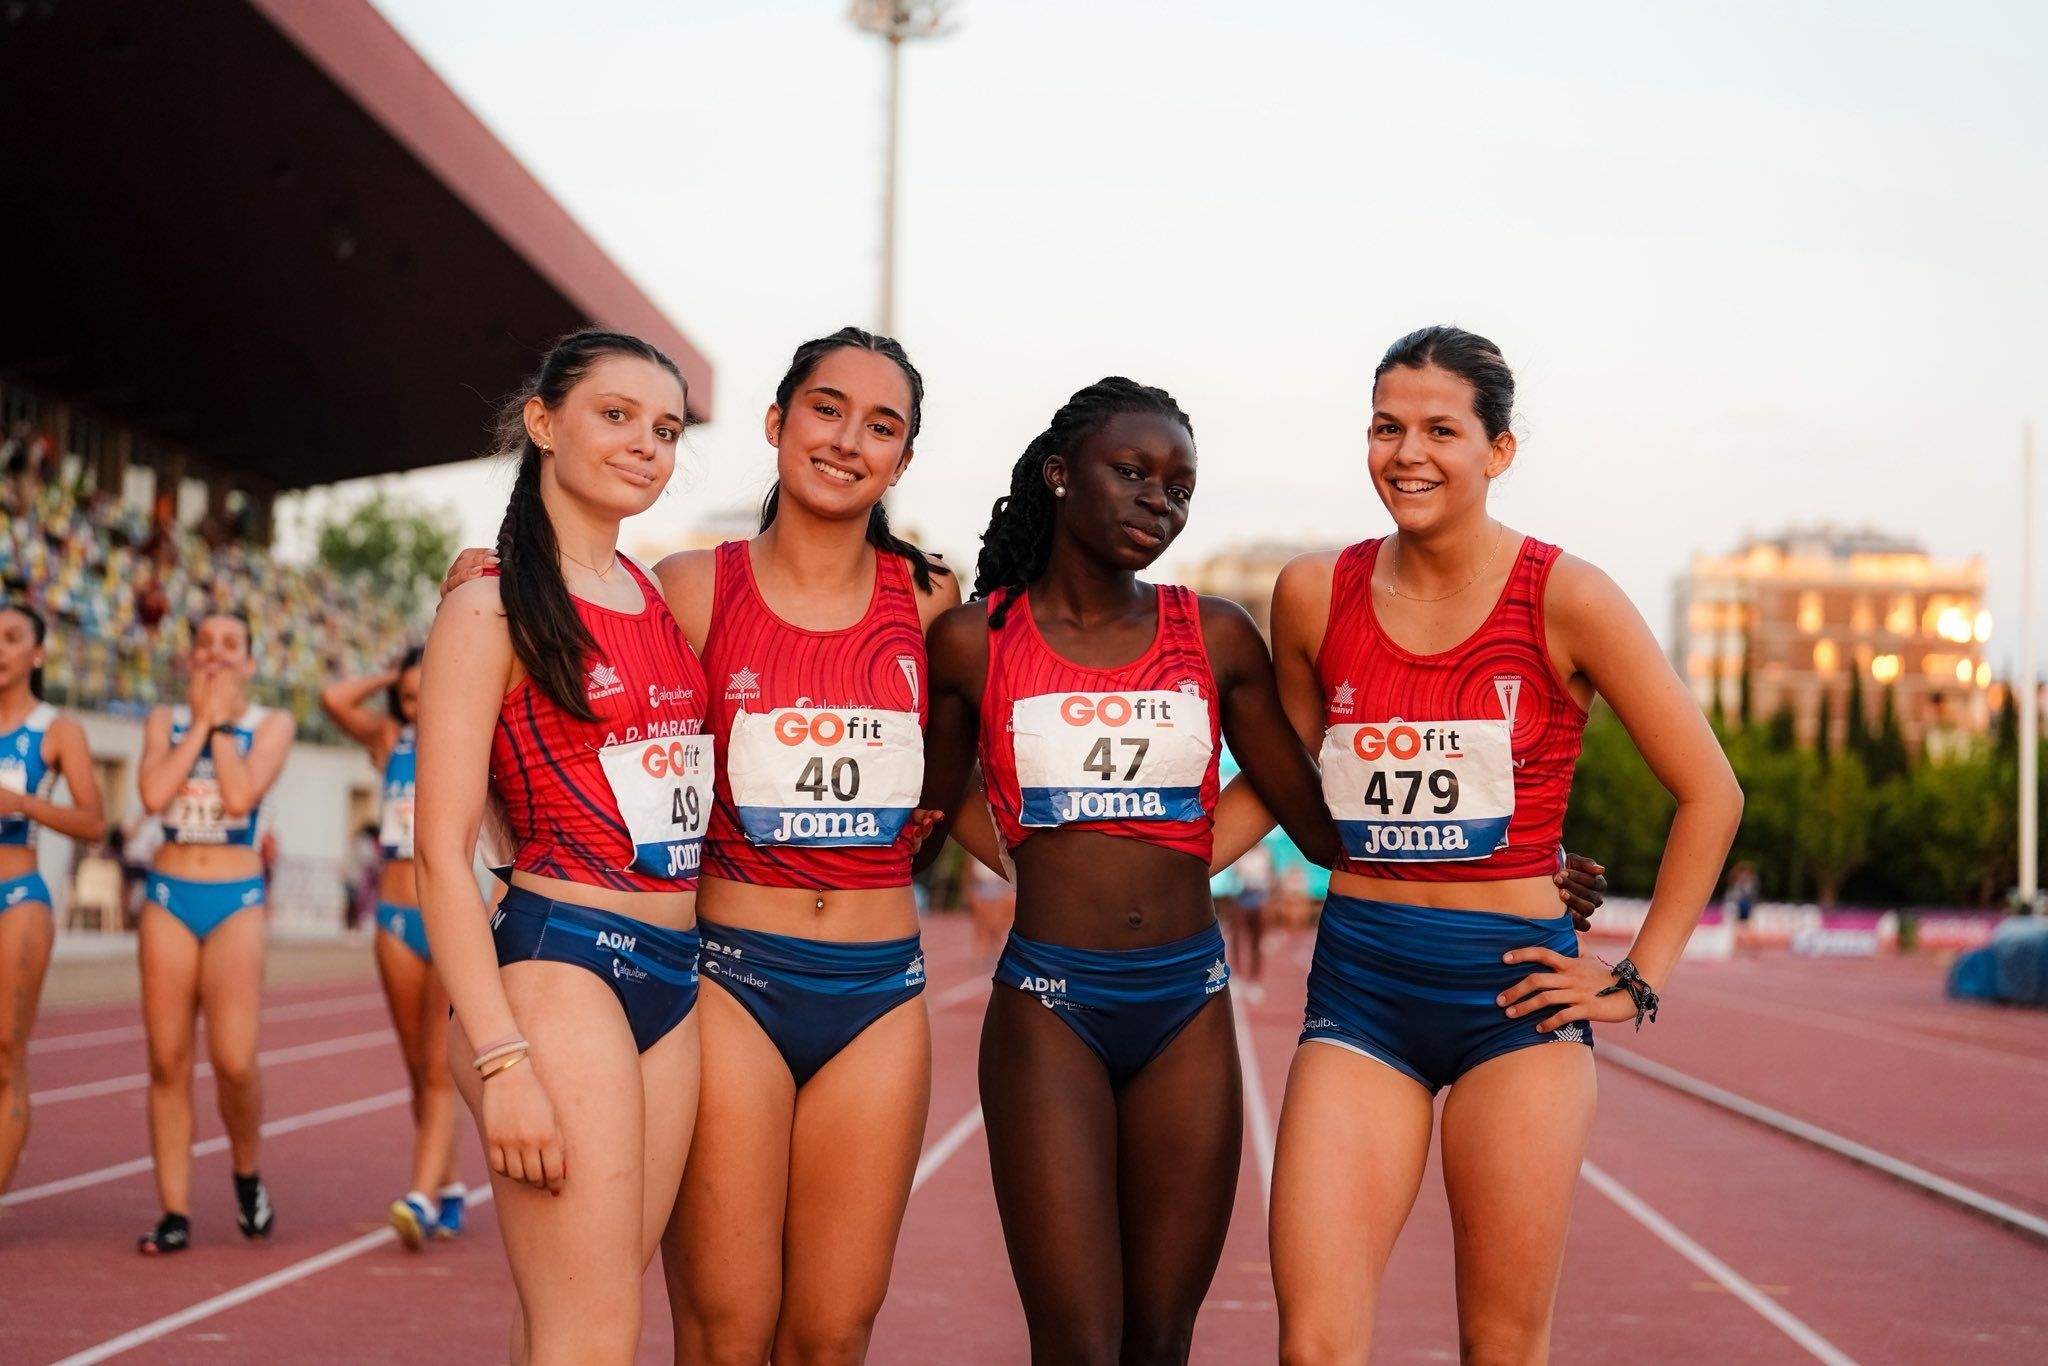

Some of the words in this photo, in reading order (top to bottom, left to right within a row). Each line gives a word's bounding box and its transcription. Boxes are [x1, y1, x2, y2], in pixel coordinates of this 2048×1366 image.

[588, 682, 625, 700] luanvi
[658, 684, 694, 706] alquiber
[725, 690, 760, 700] luanvi
[1060, 695, 1171, 727] GOfit
[604, 727, 643, 748] A.D.
[647, 718, 705, 739] MARATH
[775, 712, 882, 747] GOfit
[1353, 725, 1460, 762] GOfit
[641, 741, 700, 779] GOfit
[1082, 737, 1150, 782] 47
[795, 756, 860, 802] 40
[1363, 769, 1460, 815] 479
[671, 785, 700, 832] 49
[667, 843, 701, 877] Jom
[596, 931, 637, 952] ADM
[620, 962, 648, 982] alquiber
[1020, 976, 1066, 993] ADM
